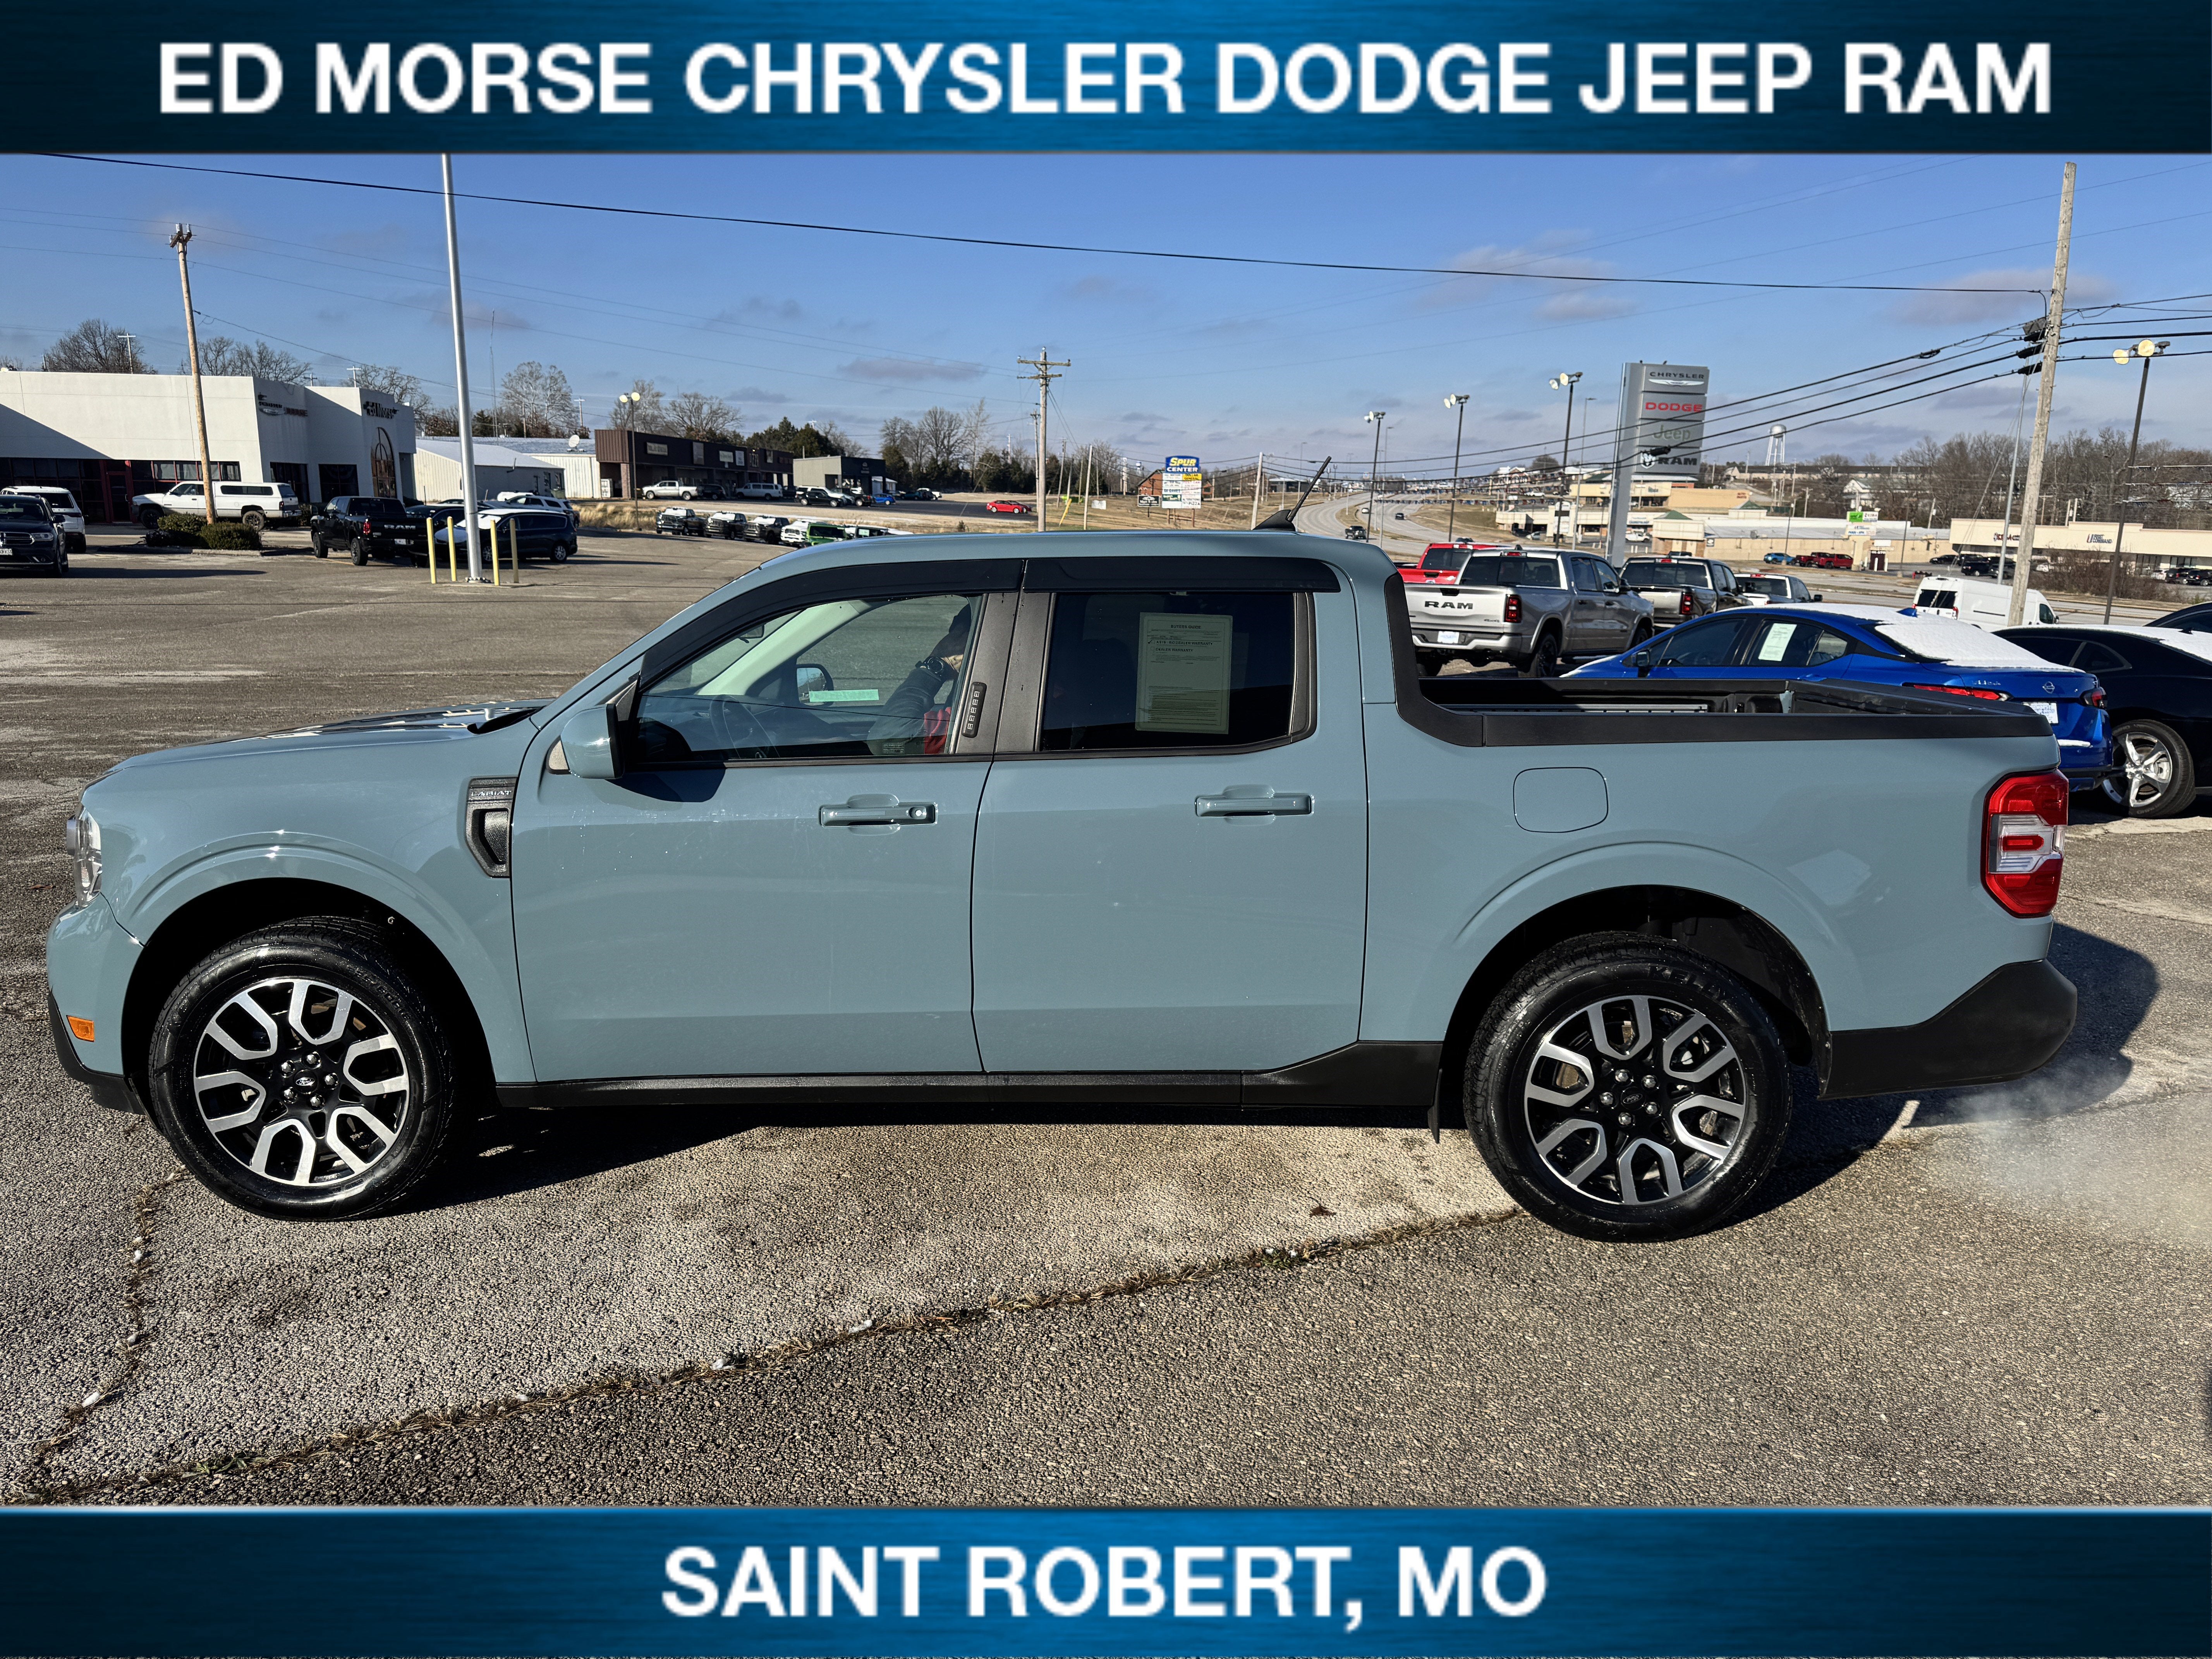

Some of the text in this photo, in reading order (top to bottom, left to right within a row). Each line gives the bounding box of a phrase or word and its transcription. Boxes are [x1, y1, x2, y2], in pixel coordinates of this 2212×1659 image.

[1645, 402, 1703, 412] DODGE
[1653, 424, 1691, 441] Jeep
[1170, 457, 1197, 466] SPUR
[1657, 457, 1697, 465] RAM
[1424, 601, 1473, 610] RAM
[1647, 965, 1721, 1000] KELLY
